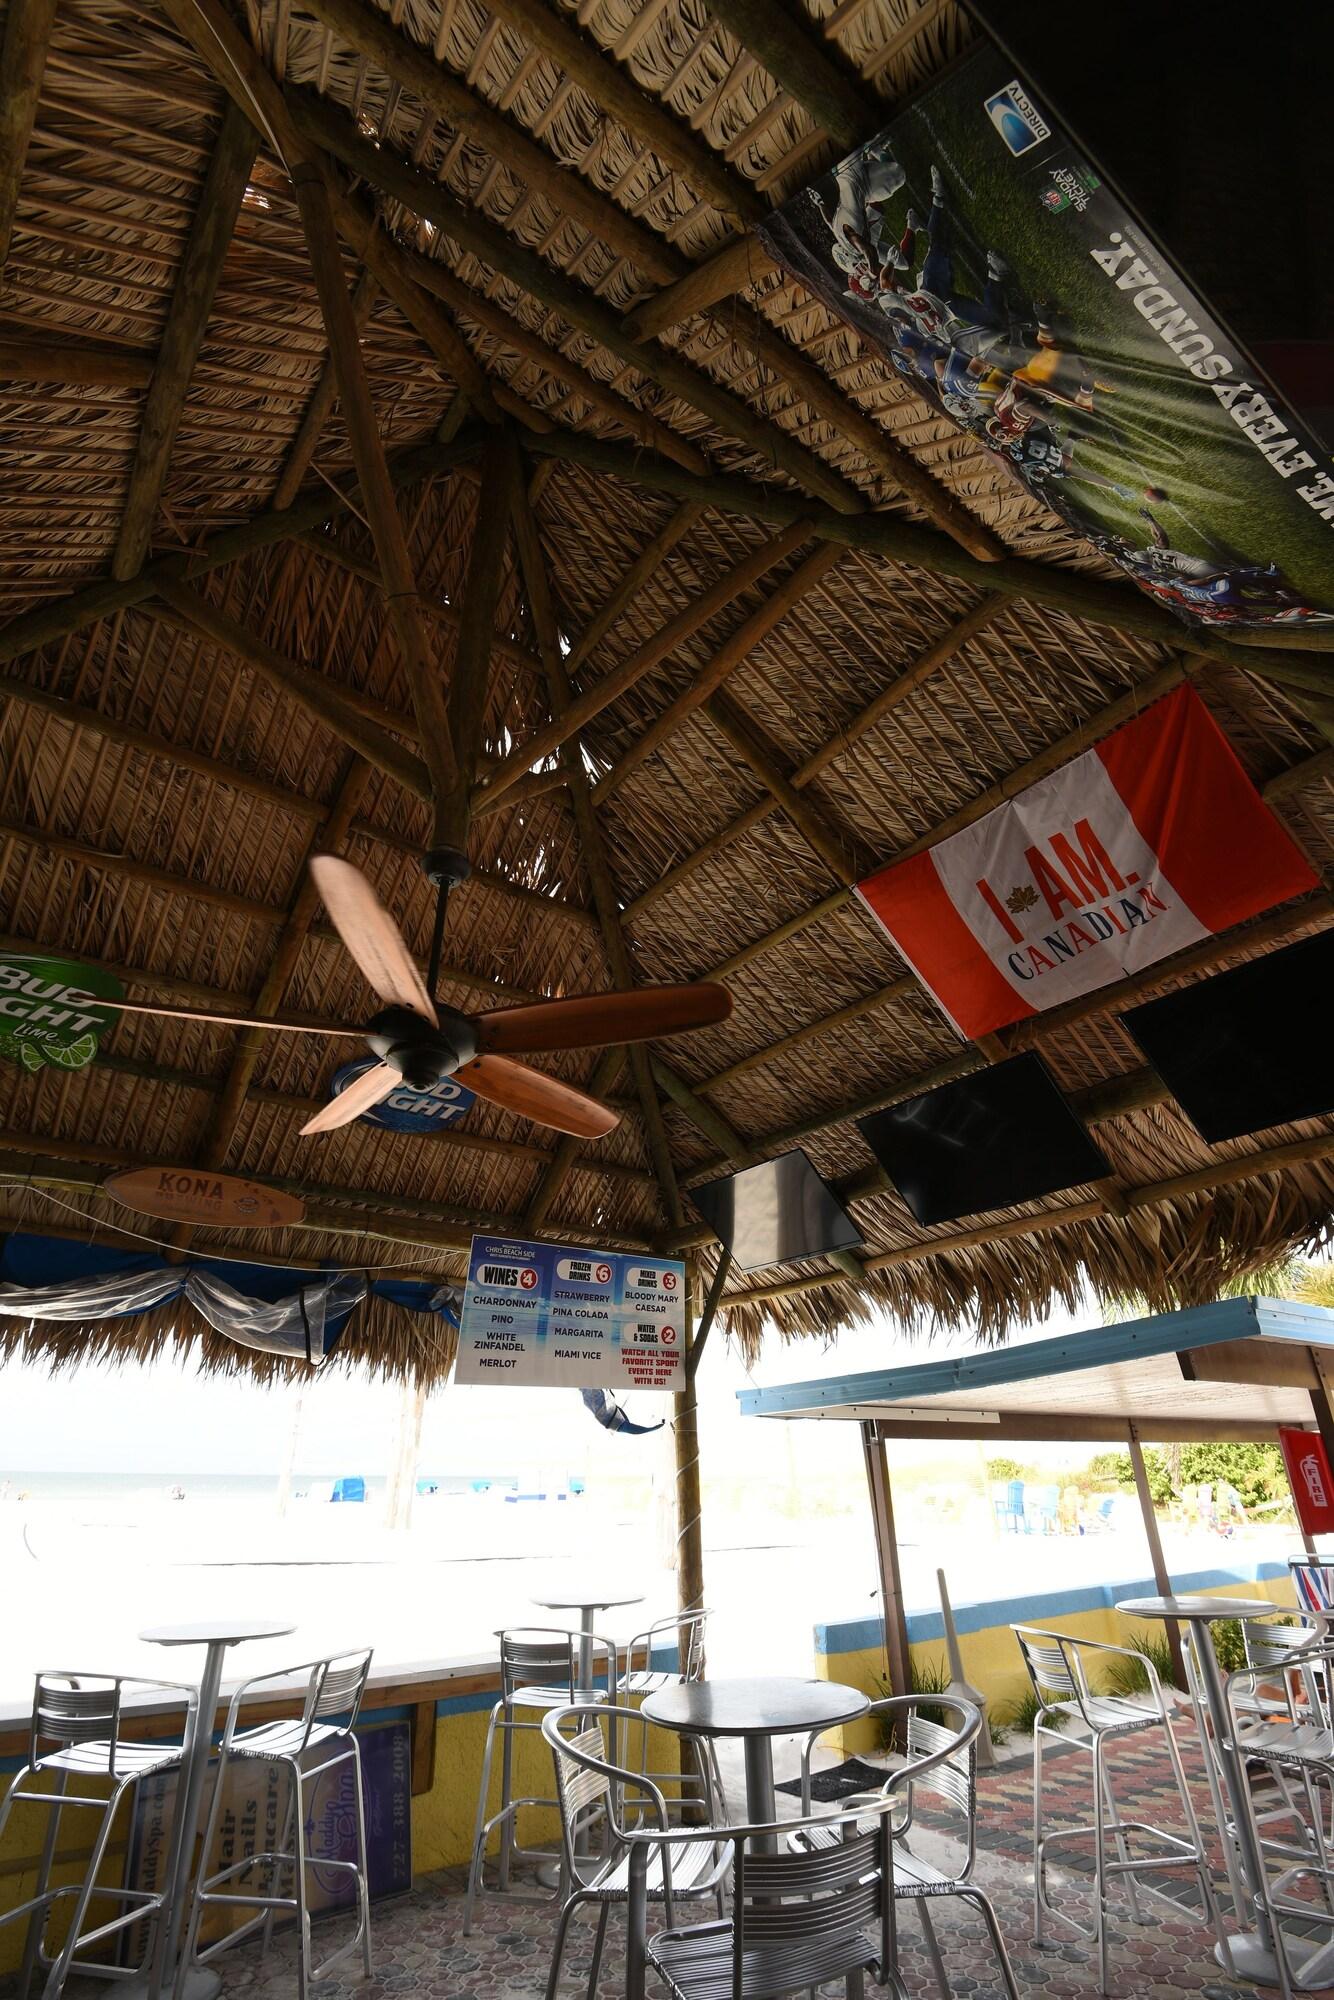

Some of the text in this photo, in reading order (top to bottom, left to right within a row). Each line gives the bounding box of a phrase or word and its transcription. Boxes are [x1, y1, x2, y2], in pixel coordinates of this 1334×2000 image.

[1009, 82, 1048, 139] DIRECTV
[1049, 168, 1086, 213] SUNDAY
[1059, 167, 1091, 205] TICKET
[1090, 232, 1233, 380] SUNDAY.
[1211, 382, 1318, 479] EVERY
[975, 818, 1142, 945] I AM.
[13, 1022, 58, 1041] Lime
[159, 1172, 224, 1199] KONA
[485, 1245, 502, 1255] CHRIS
[503, 1247, 522, 1256] BEACH
[523, 1249, 536, 1258] SIDE
[570, 1261, 591, 1272] FROZEN
[484, 1266, 518, 1286] WINES
[568, 1271, 591, 1281] DRINKS
[472, 1296, 537, 1309] CHARDONNAY
[554, 1290, 610, 1303] STRAWBERRY
[625, 1291, 679, 1303] BLOODY MARY
[552, 1307, 609, 1320] PINA COLADA
[635, 1304, 666, 1313] CAESAR
[491, 1314, 514, 1324] PINO
[554, 1327, 604, 1339] MARGARITA
[638, 1324, 656, 1334] WATER
[486, 1331, 517, 1341] WHITE
[640, 1333, 659, 1343] SODAS
[473, 1340, 526, 1352] ZINFANDEL
[554, 1349, 602, 1360] MIAMI VICE
[621, 1348, 680, 1358] WATCH ALL YOUR
[479, 1358, 517, 1368] MERLOT
[622, 1357, 679, 1367] FAVORITE SPORT
[628, 1367, 672, 1376] EVENTS HERE
[634, 1377, 666, 1386] WITH US!
[1307, 1468, 1325, 1503] FIRE
